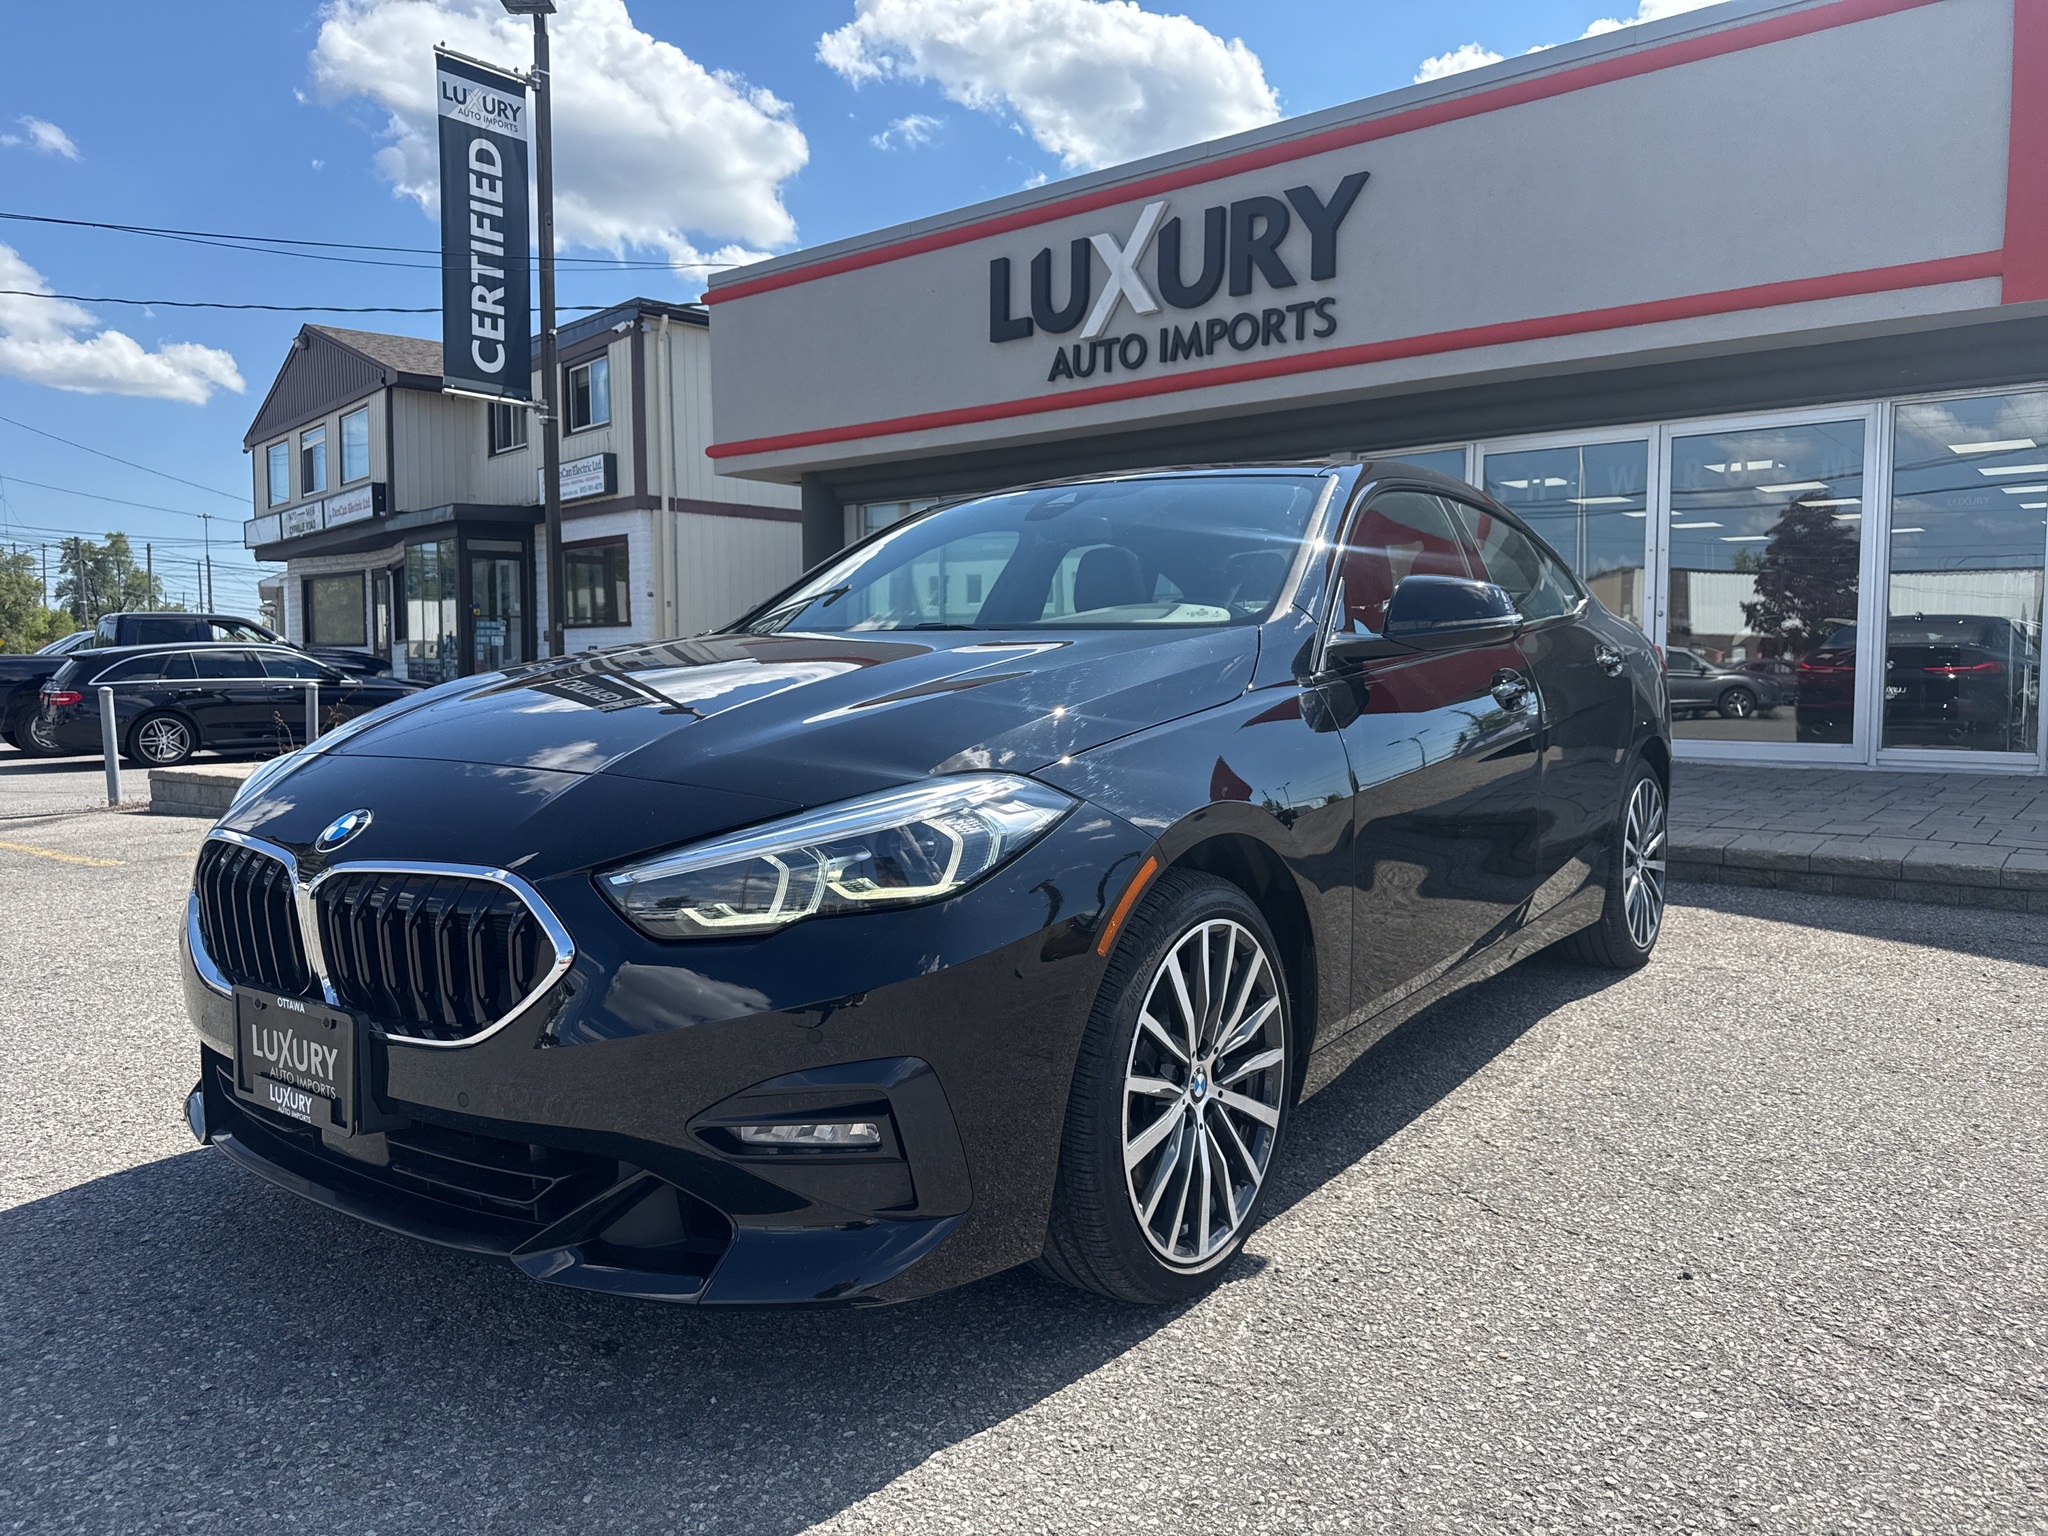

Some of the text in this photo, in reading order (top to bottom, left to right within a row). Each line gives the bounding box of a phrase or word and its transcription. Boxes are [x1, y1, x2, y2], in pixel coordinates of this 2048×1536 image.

[442, 79, 522, 123] LUXURY
[458, 106, 519, 133] AUTO IMPORTS
[468, 137, 505, 373] CERTIFIED
[989, 170, 1371, 343] LUXURY
[1047, 297, 1338, 381] AUTO IMPORTS
[572, 462, 592, 476] Electric
[277, 997, 305, 1014] OTTAWA
[252, 1024, 338, 1081] LUXURY
[269, 1084, 312, 1114] LUXURY
[270, 1067, 336, 1100] AUTO IMPORTS
[277, 1106, 312, 1124] AUTO IMPORTS
